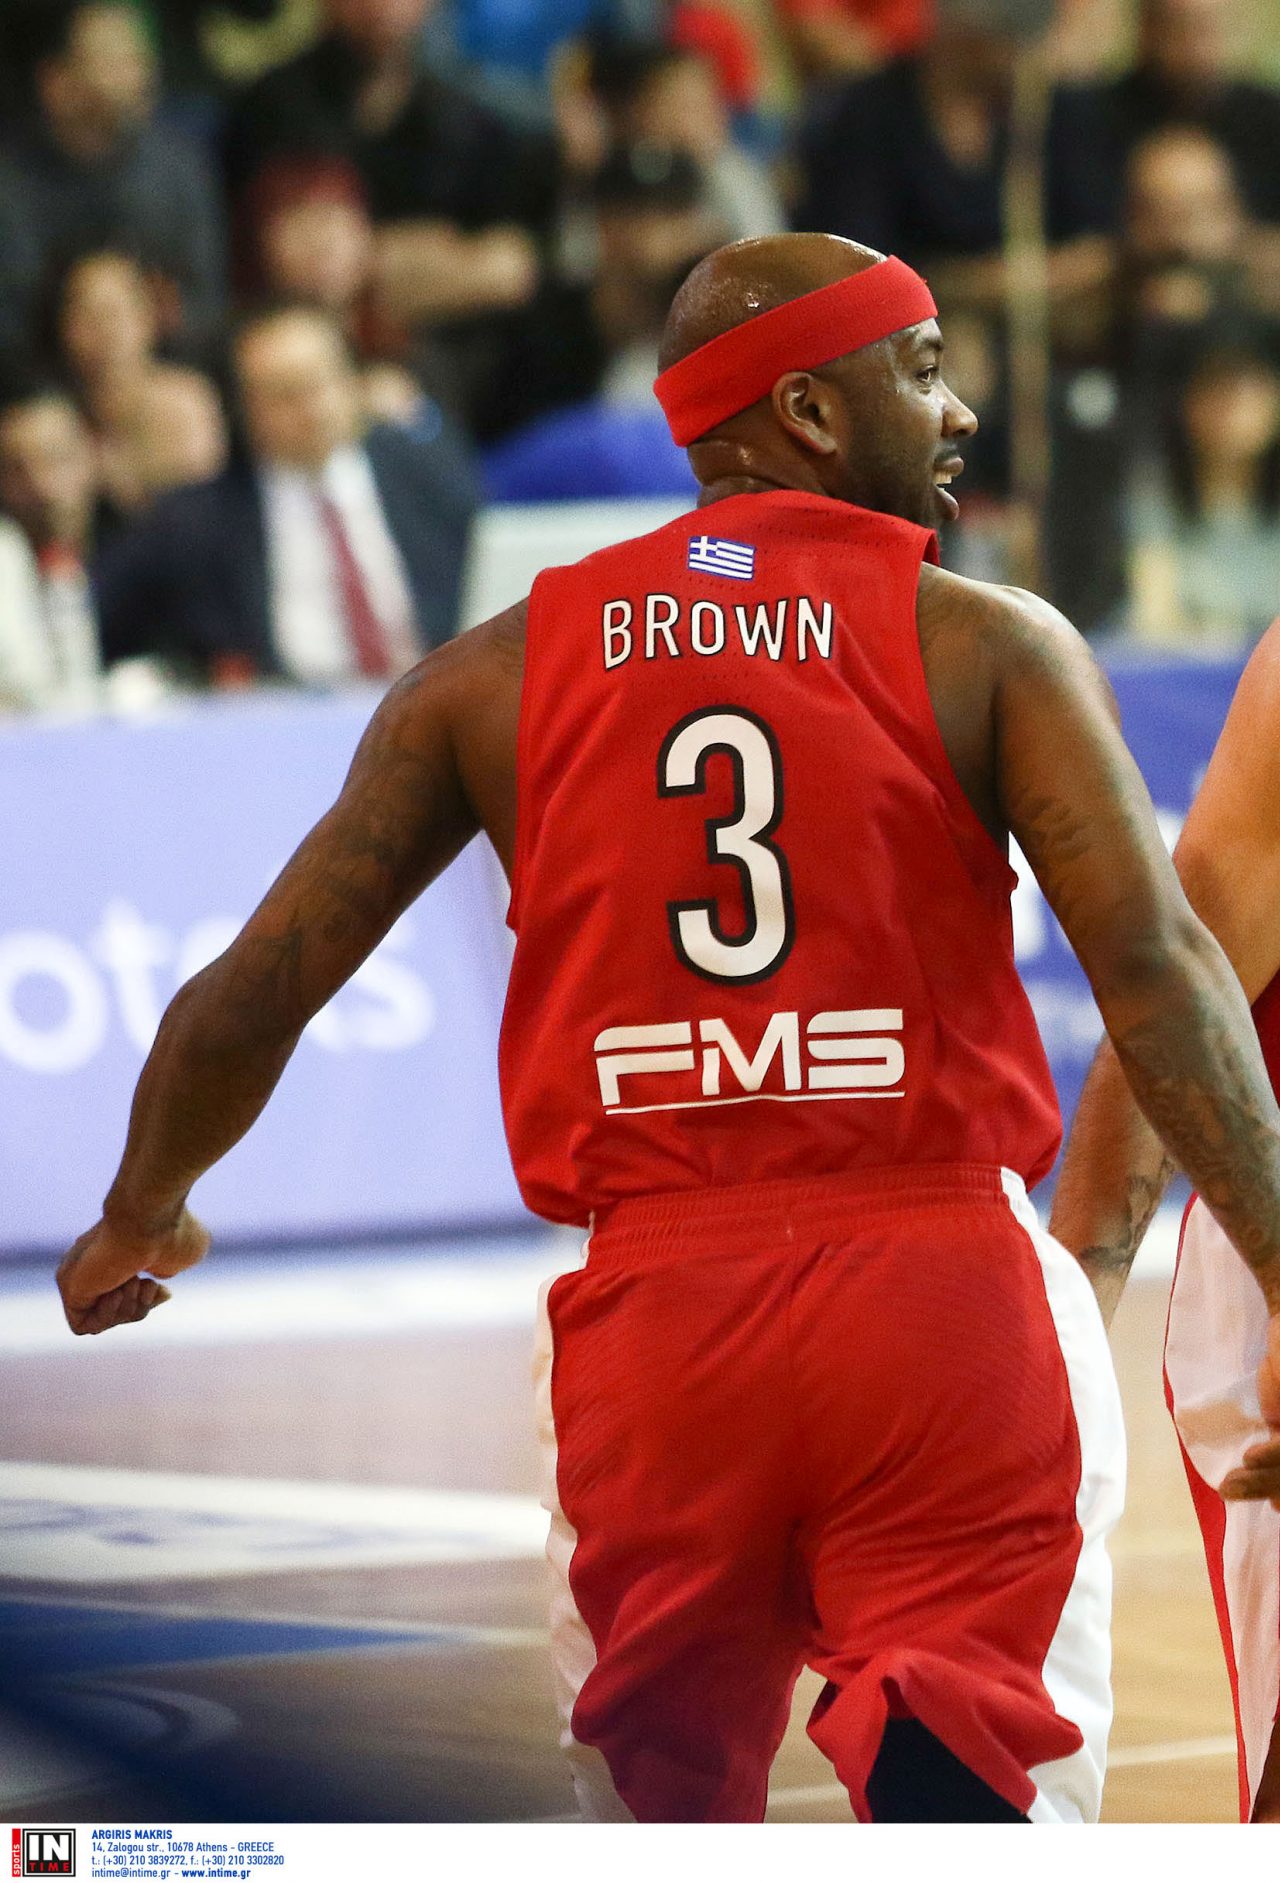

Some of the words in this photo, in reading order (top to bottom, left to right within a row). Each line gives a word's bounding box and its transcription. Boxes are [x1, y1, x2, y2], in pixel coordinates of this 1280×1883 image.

[602, 593, 832, 670] BROWN
[657, 705, 796, 986] 3
[593, 1008, 905, 1108] FMS
